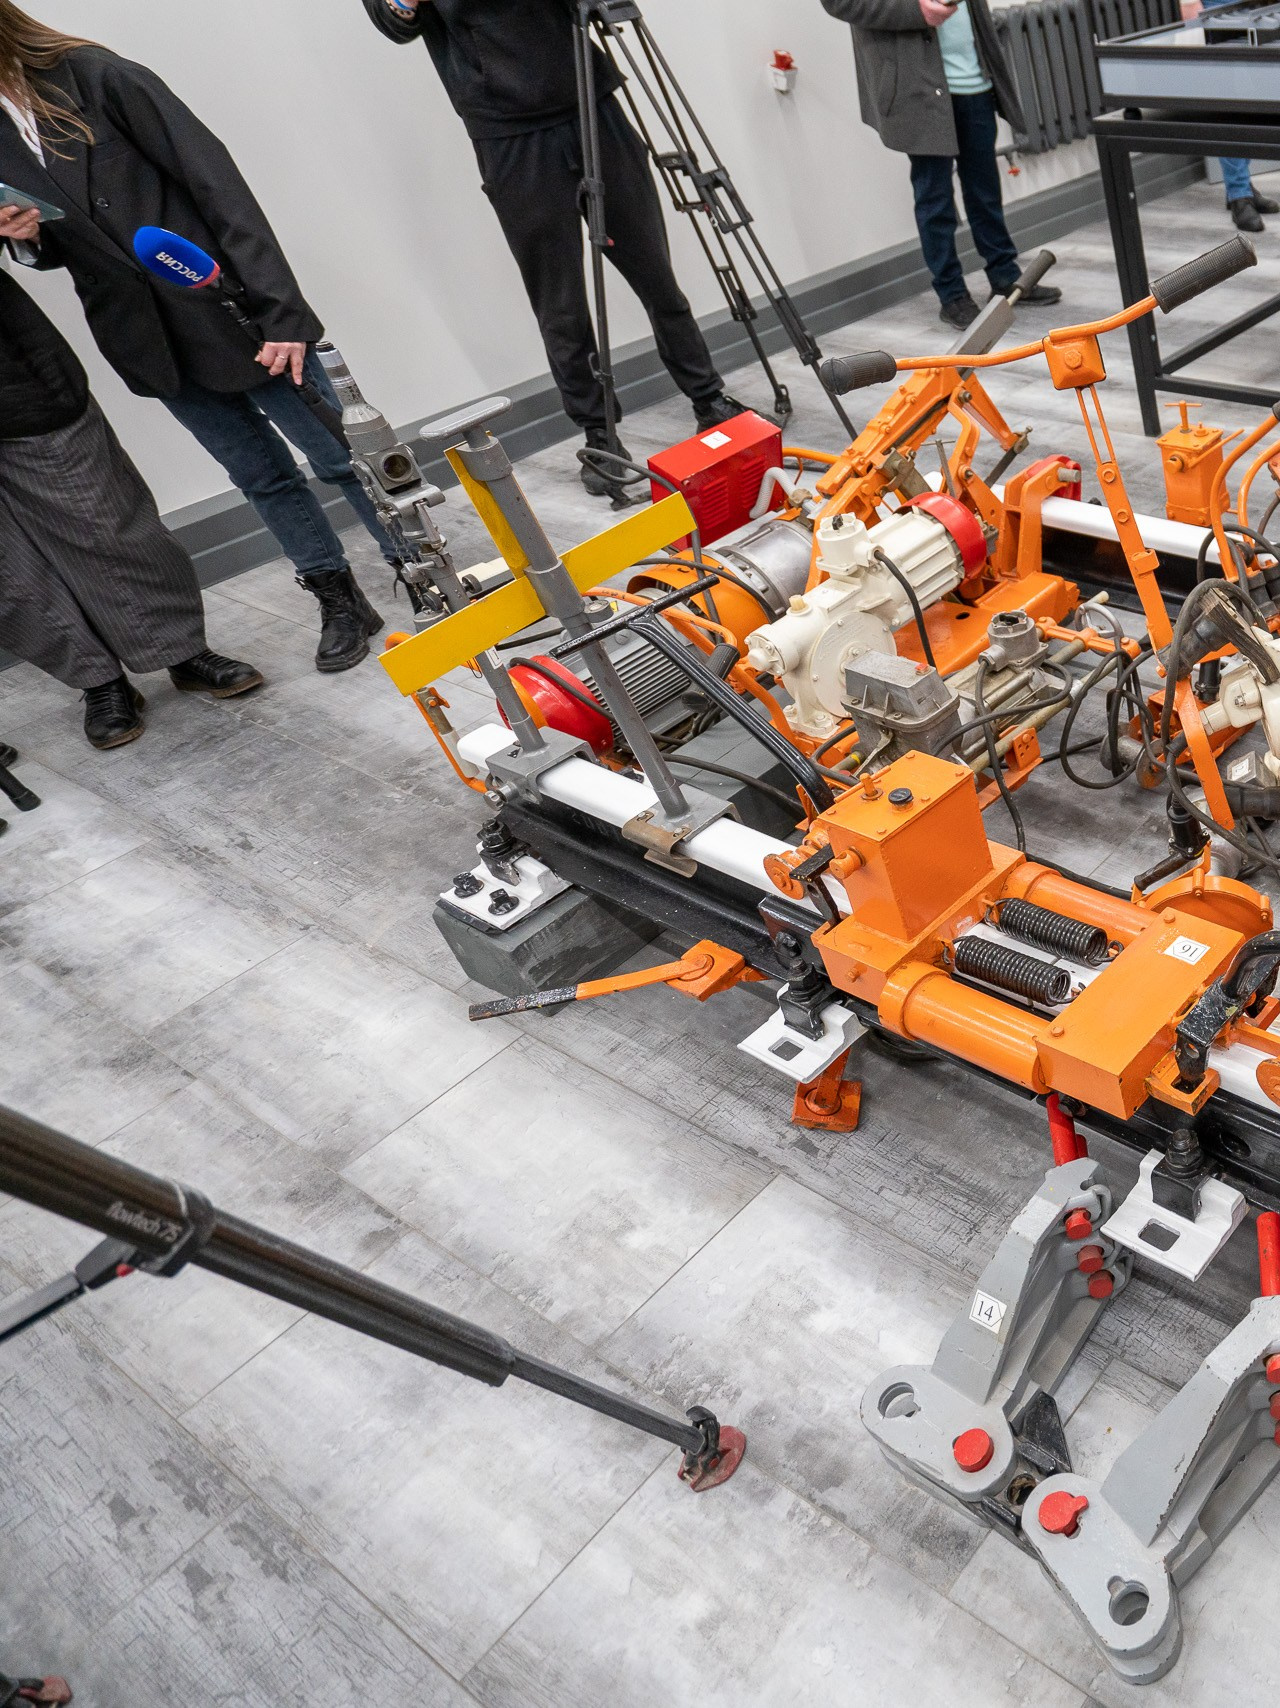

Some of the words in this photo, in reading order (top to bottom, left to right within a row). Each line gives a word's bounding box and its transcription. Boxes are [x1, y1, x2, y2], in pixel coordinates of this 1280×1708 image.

[155, 251, 204, 283] РОССИЯ
[106, 1200, 161, 1236] flowtech
[159, 1220, 182, 1244] 75
[977, 1300, 994, 1321] 14
